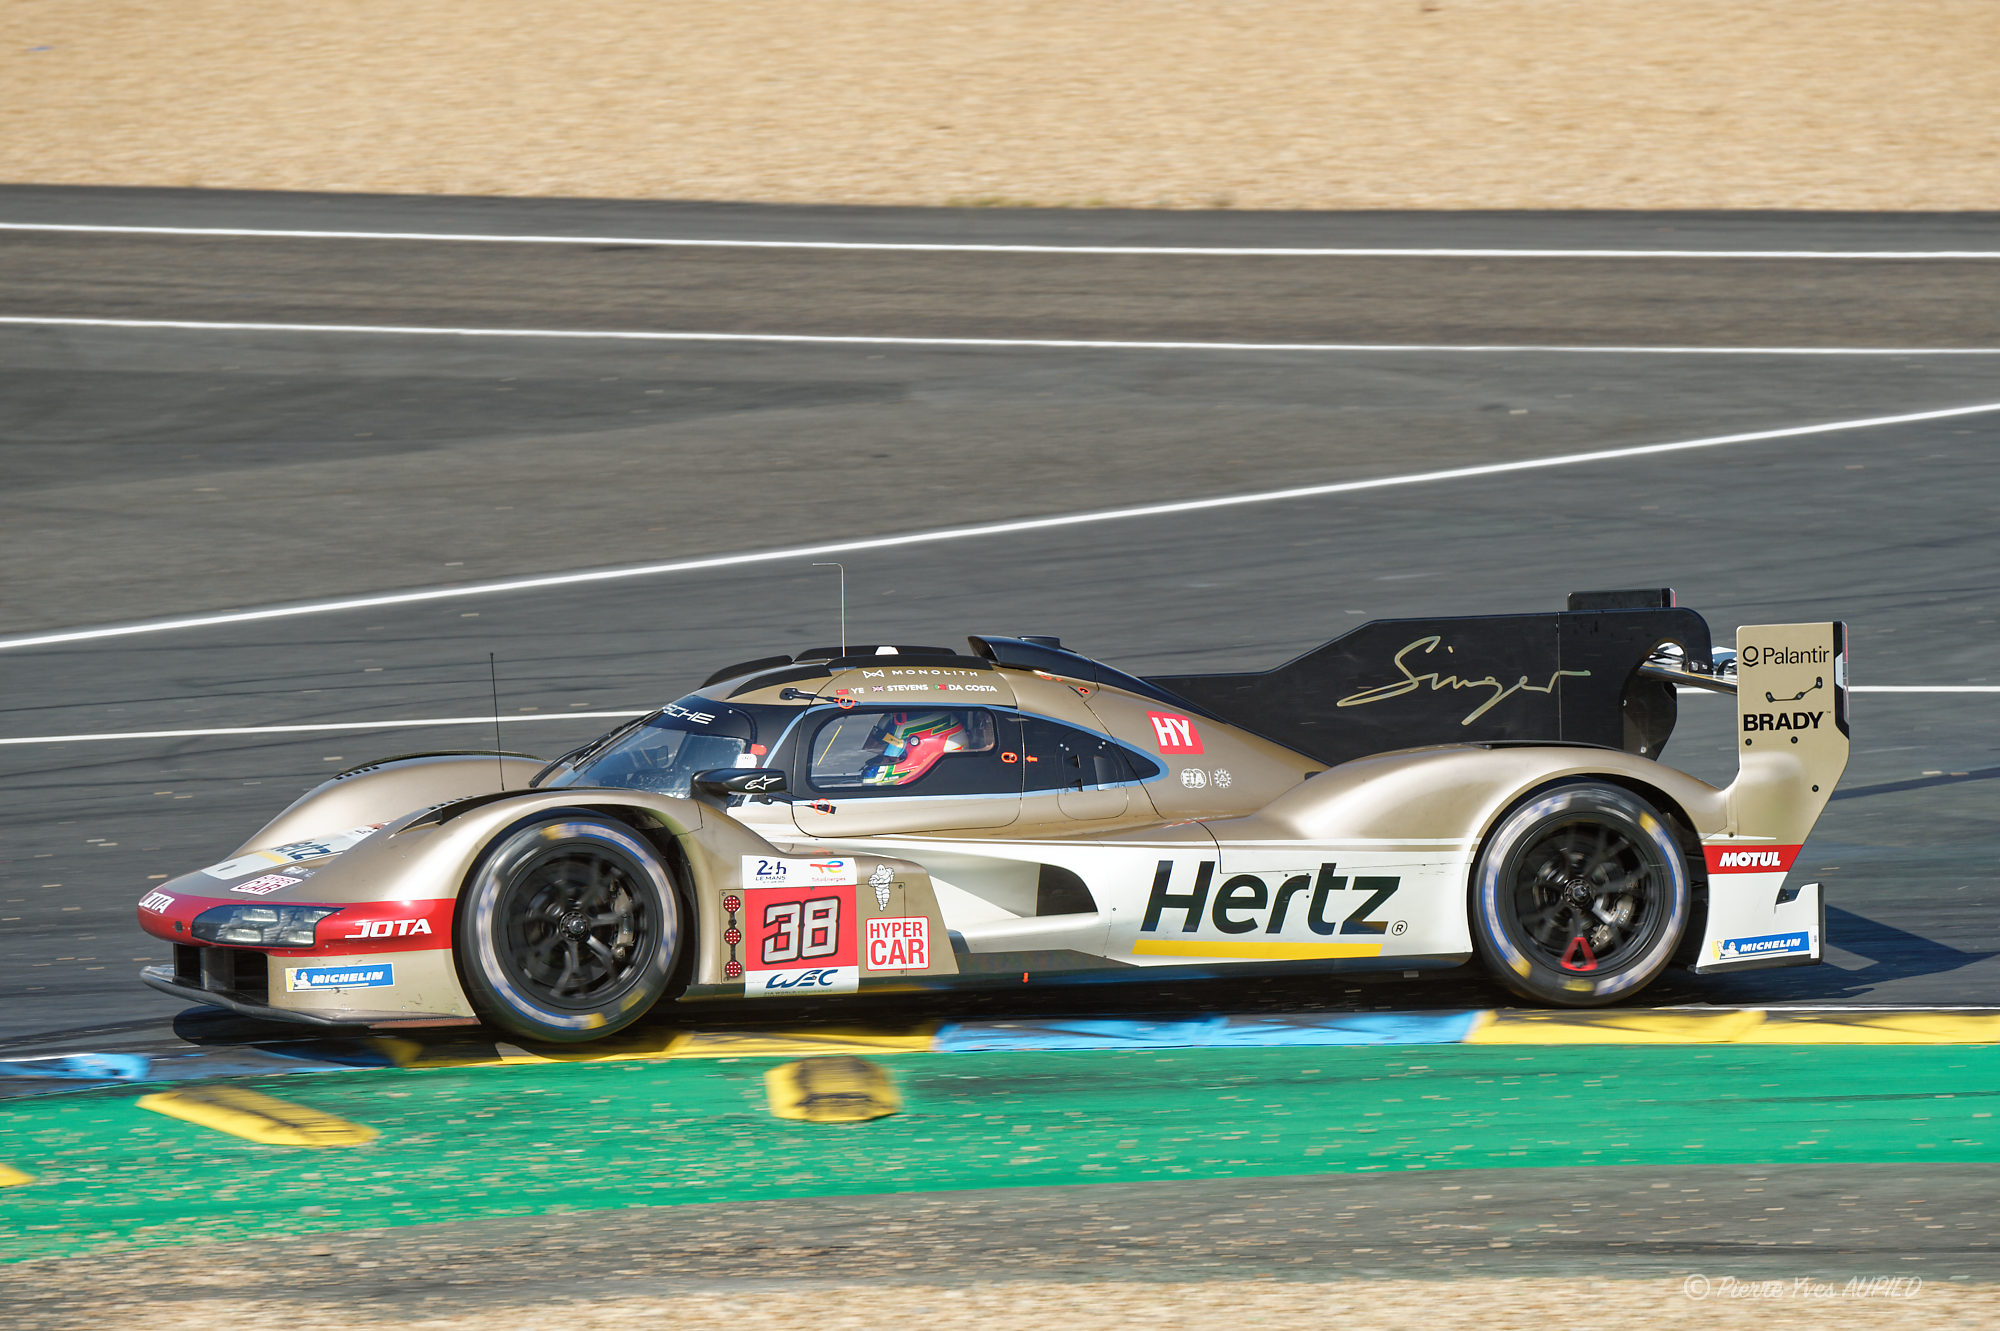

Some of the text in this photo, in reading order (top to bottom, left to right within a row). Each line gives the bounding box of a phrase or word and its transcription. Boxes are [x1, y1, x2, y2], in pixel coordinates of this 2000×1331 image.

[1763, 646, 1830, 665] Palantir
[891, 669, 978, 677] MONOLITH
[1336, 634, 1592, 726] Singer
[886, 684, 929, 692] STEVENS
[964, 684, 998, 692] COSTA
[662, 703, 716, 725] SCHE
[1743, 711, 1824, 731] BRADY
[1151, 717, 1193, 746] HY
[1719, 851, 1781, 867] MOTUL
[138, 892, 176, 914] JOTA
[1140, 860, 1402, 936] Hertz
[345, 919, 433, 939] JOTA
[761, 896, 841, 965] 38
[869, 921, 923, 939] HYPER
[870, 938, 925, 966] CAR
[1739, 937, 1802, 952] MICHELIN
[311, 969, 384, 986] MICHELIN
[765, 969, 839, 988] WEC
